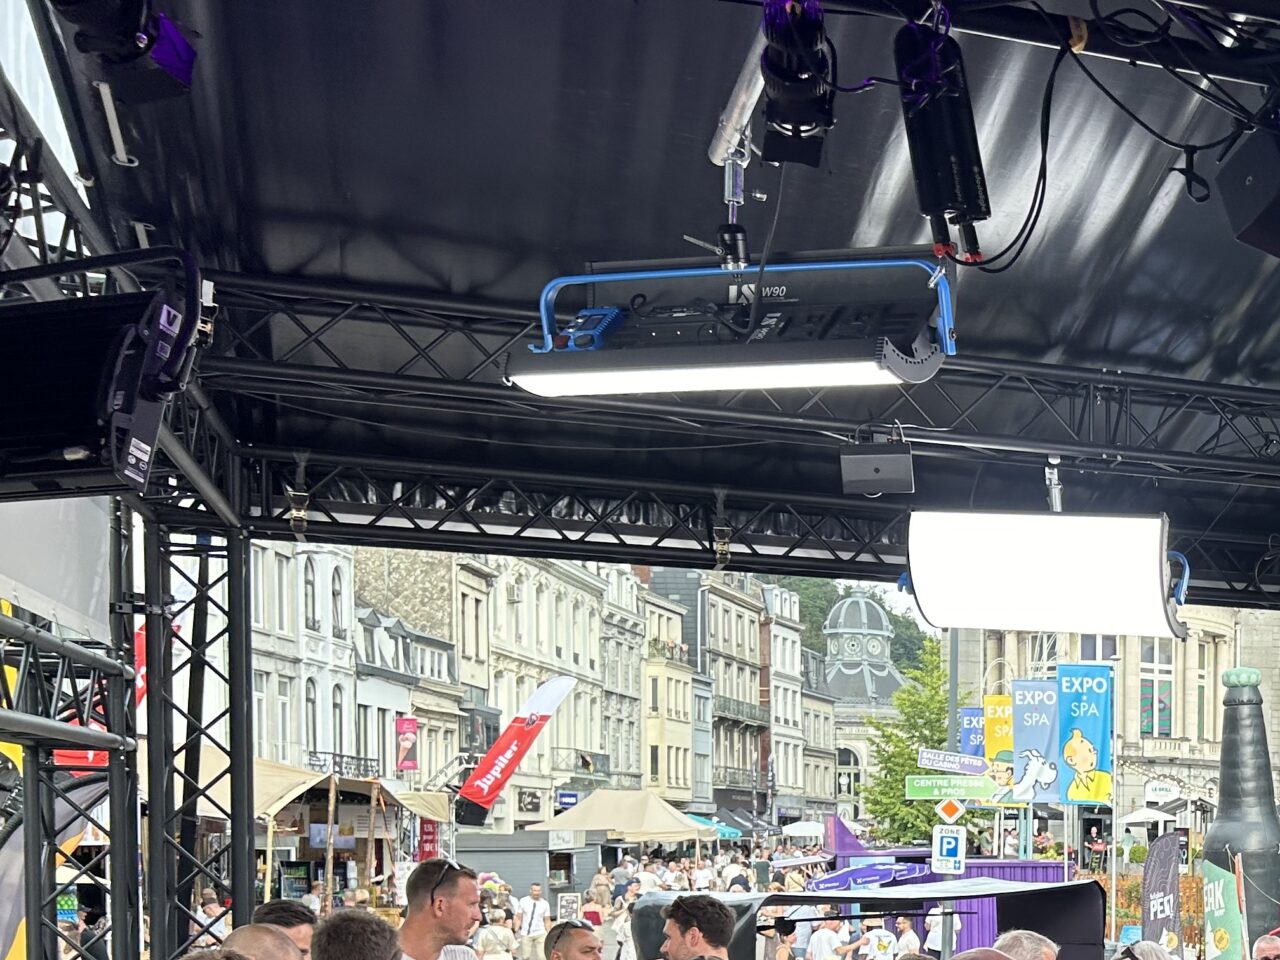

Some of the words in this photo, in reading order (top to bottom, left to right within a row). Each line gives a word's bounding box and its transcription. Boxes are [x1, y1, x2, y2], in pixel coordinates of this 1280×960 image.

[761, 286, 787, 297] W90
[1062, 677, 1107, 694] EXPO
[1015, 691, 1056, 705] EXPO
[988, 705, 1012, 718] EXP
[1071, 703, 1099, 717] SPA
[1024, 713, 1049, 726] SPA
[970, 735, 985, 745] SP
[922, 751, 945, 760] SALLE
[945, 755, 960, 763] DES
[474, 739, 518, 796] Jupiler
[933, 760, 960, 769] CASINO
[941, 788, 965, 796] PROS
[942, 838, 956, 856] P
